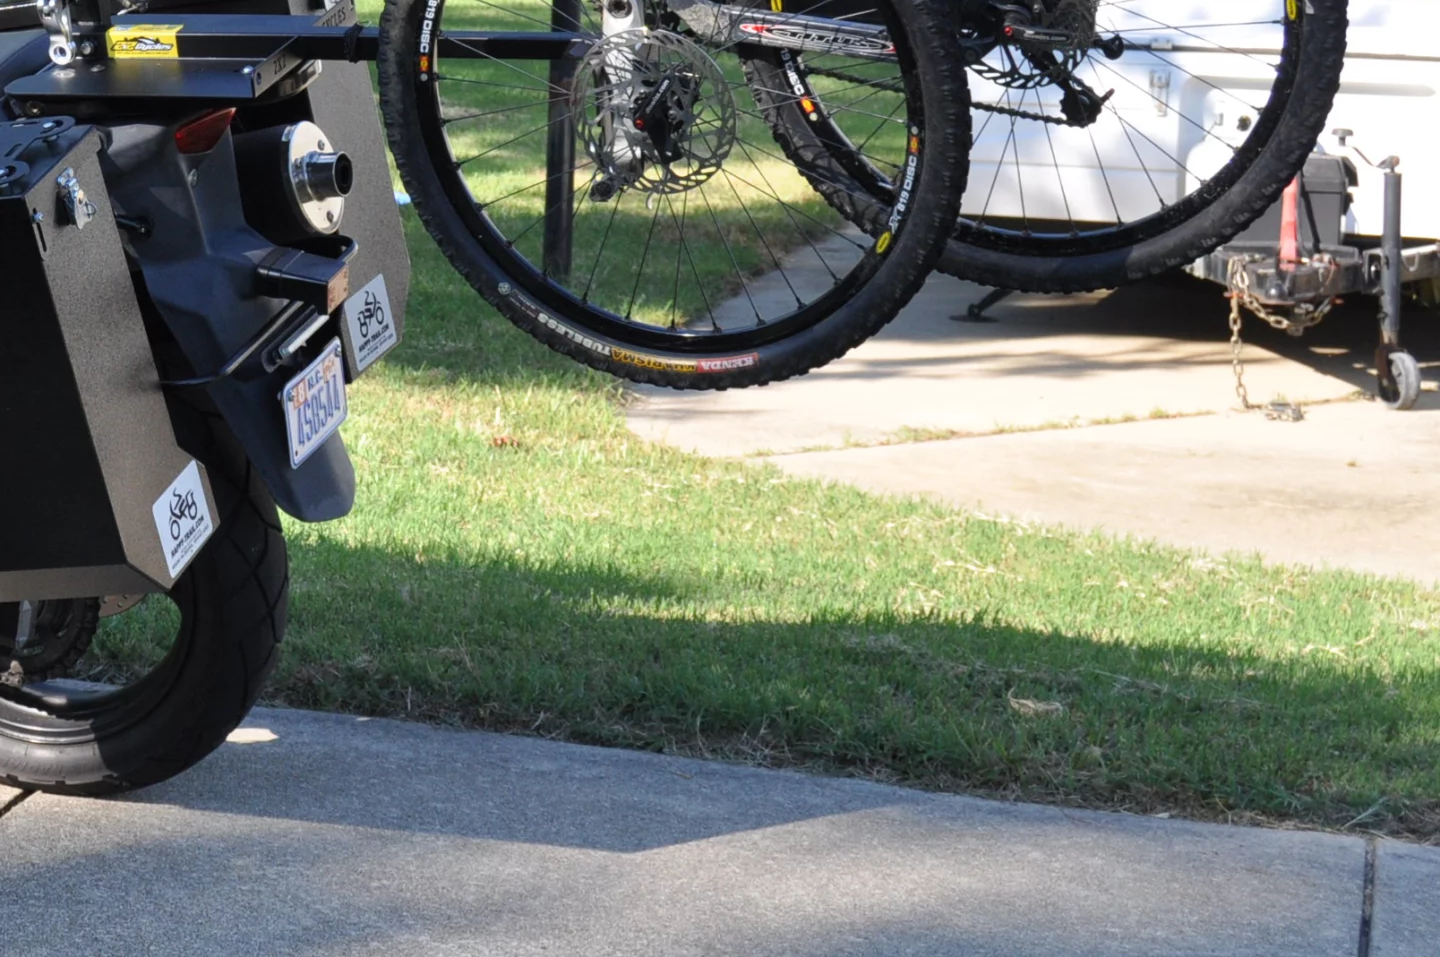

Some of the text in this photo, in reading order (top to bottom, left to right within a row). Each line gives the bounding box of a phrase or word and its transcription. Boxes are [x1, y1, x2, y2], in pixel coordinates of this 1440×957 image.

[425, 0, 437, 19] 819
[420, 20, 433, 54] DISC
[780, 47, 805, 96] 19 DISC
[897, 191, 909, 212] 819
[903, 155, 917, 191] DISC
[536, 312, 612, 357] TUBELESS
